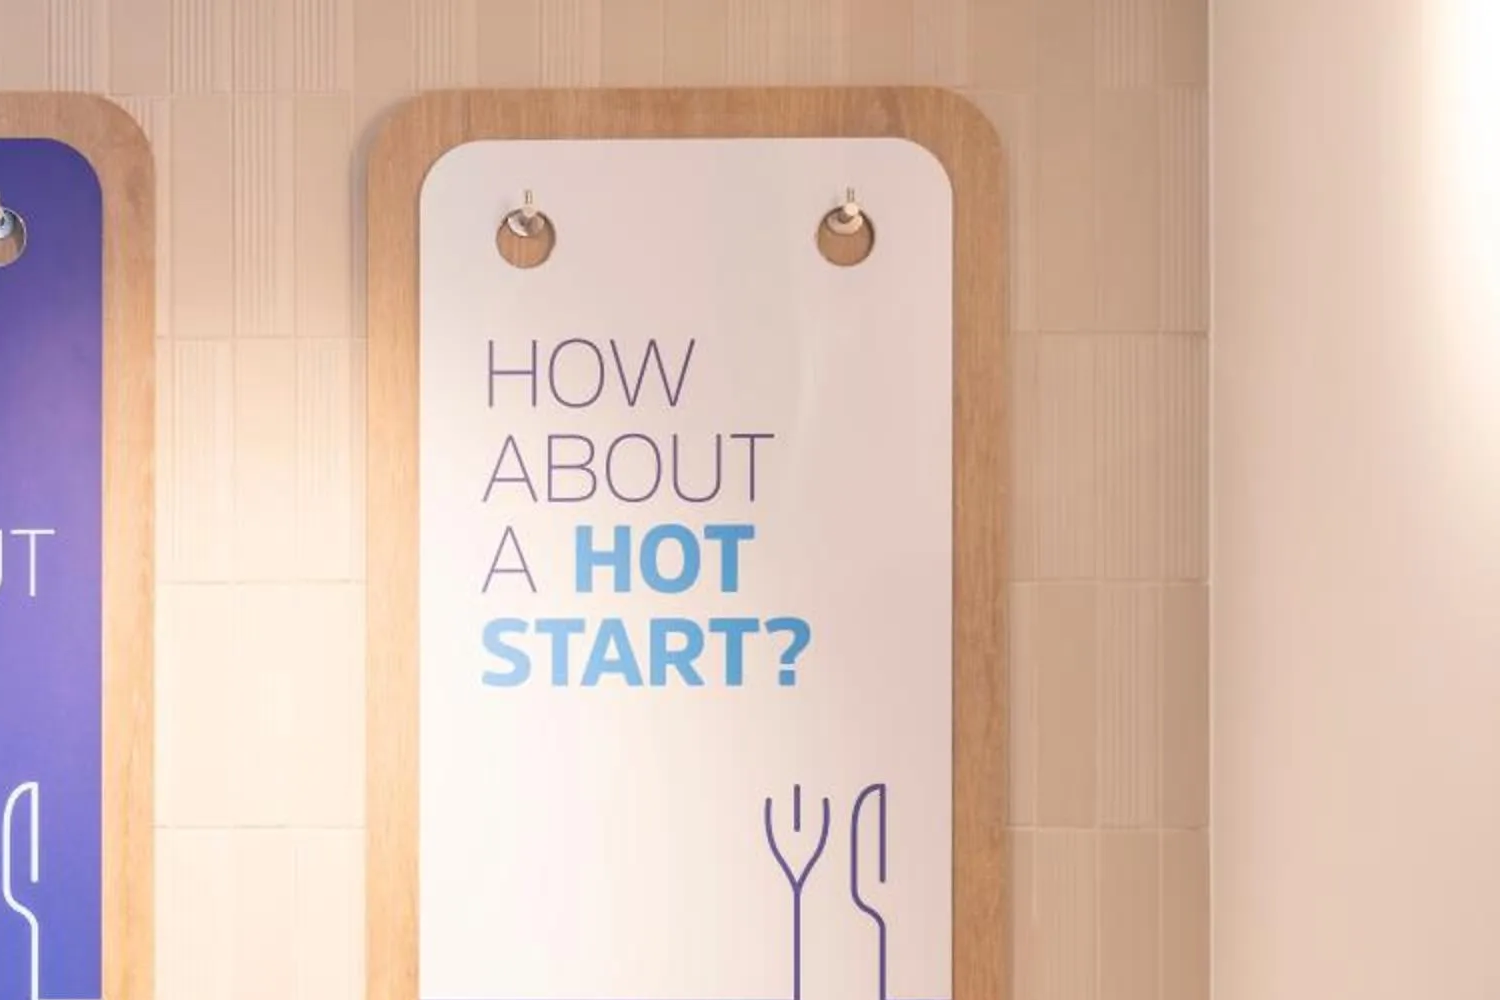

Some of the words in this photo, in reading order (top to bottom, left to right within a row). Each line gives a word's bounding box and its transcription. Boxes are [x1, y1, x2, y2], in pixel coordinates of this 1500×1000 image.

[488, 338, 695, 408] HOW
[482, 433, 775, 502] ABOUT
[482, 525, 537, 593] A
[575, 523, 755, 593] HOT
[481, 616, 811, 687] START?
